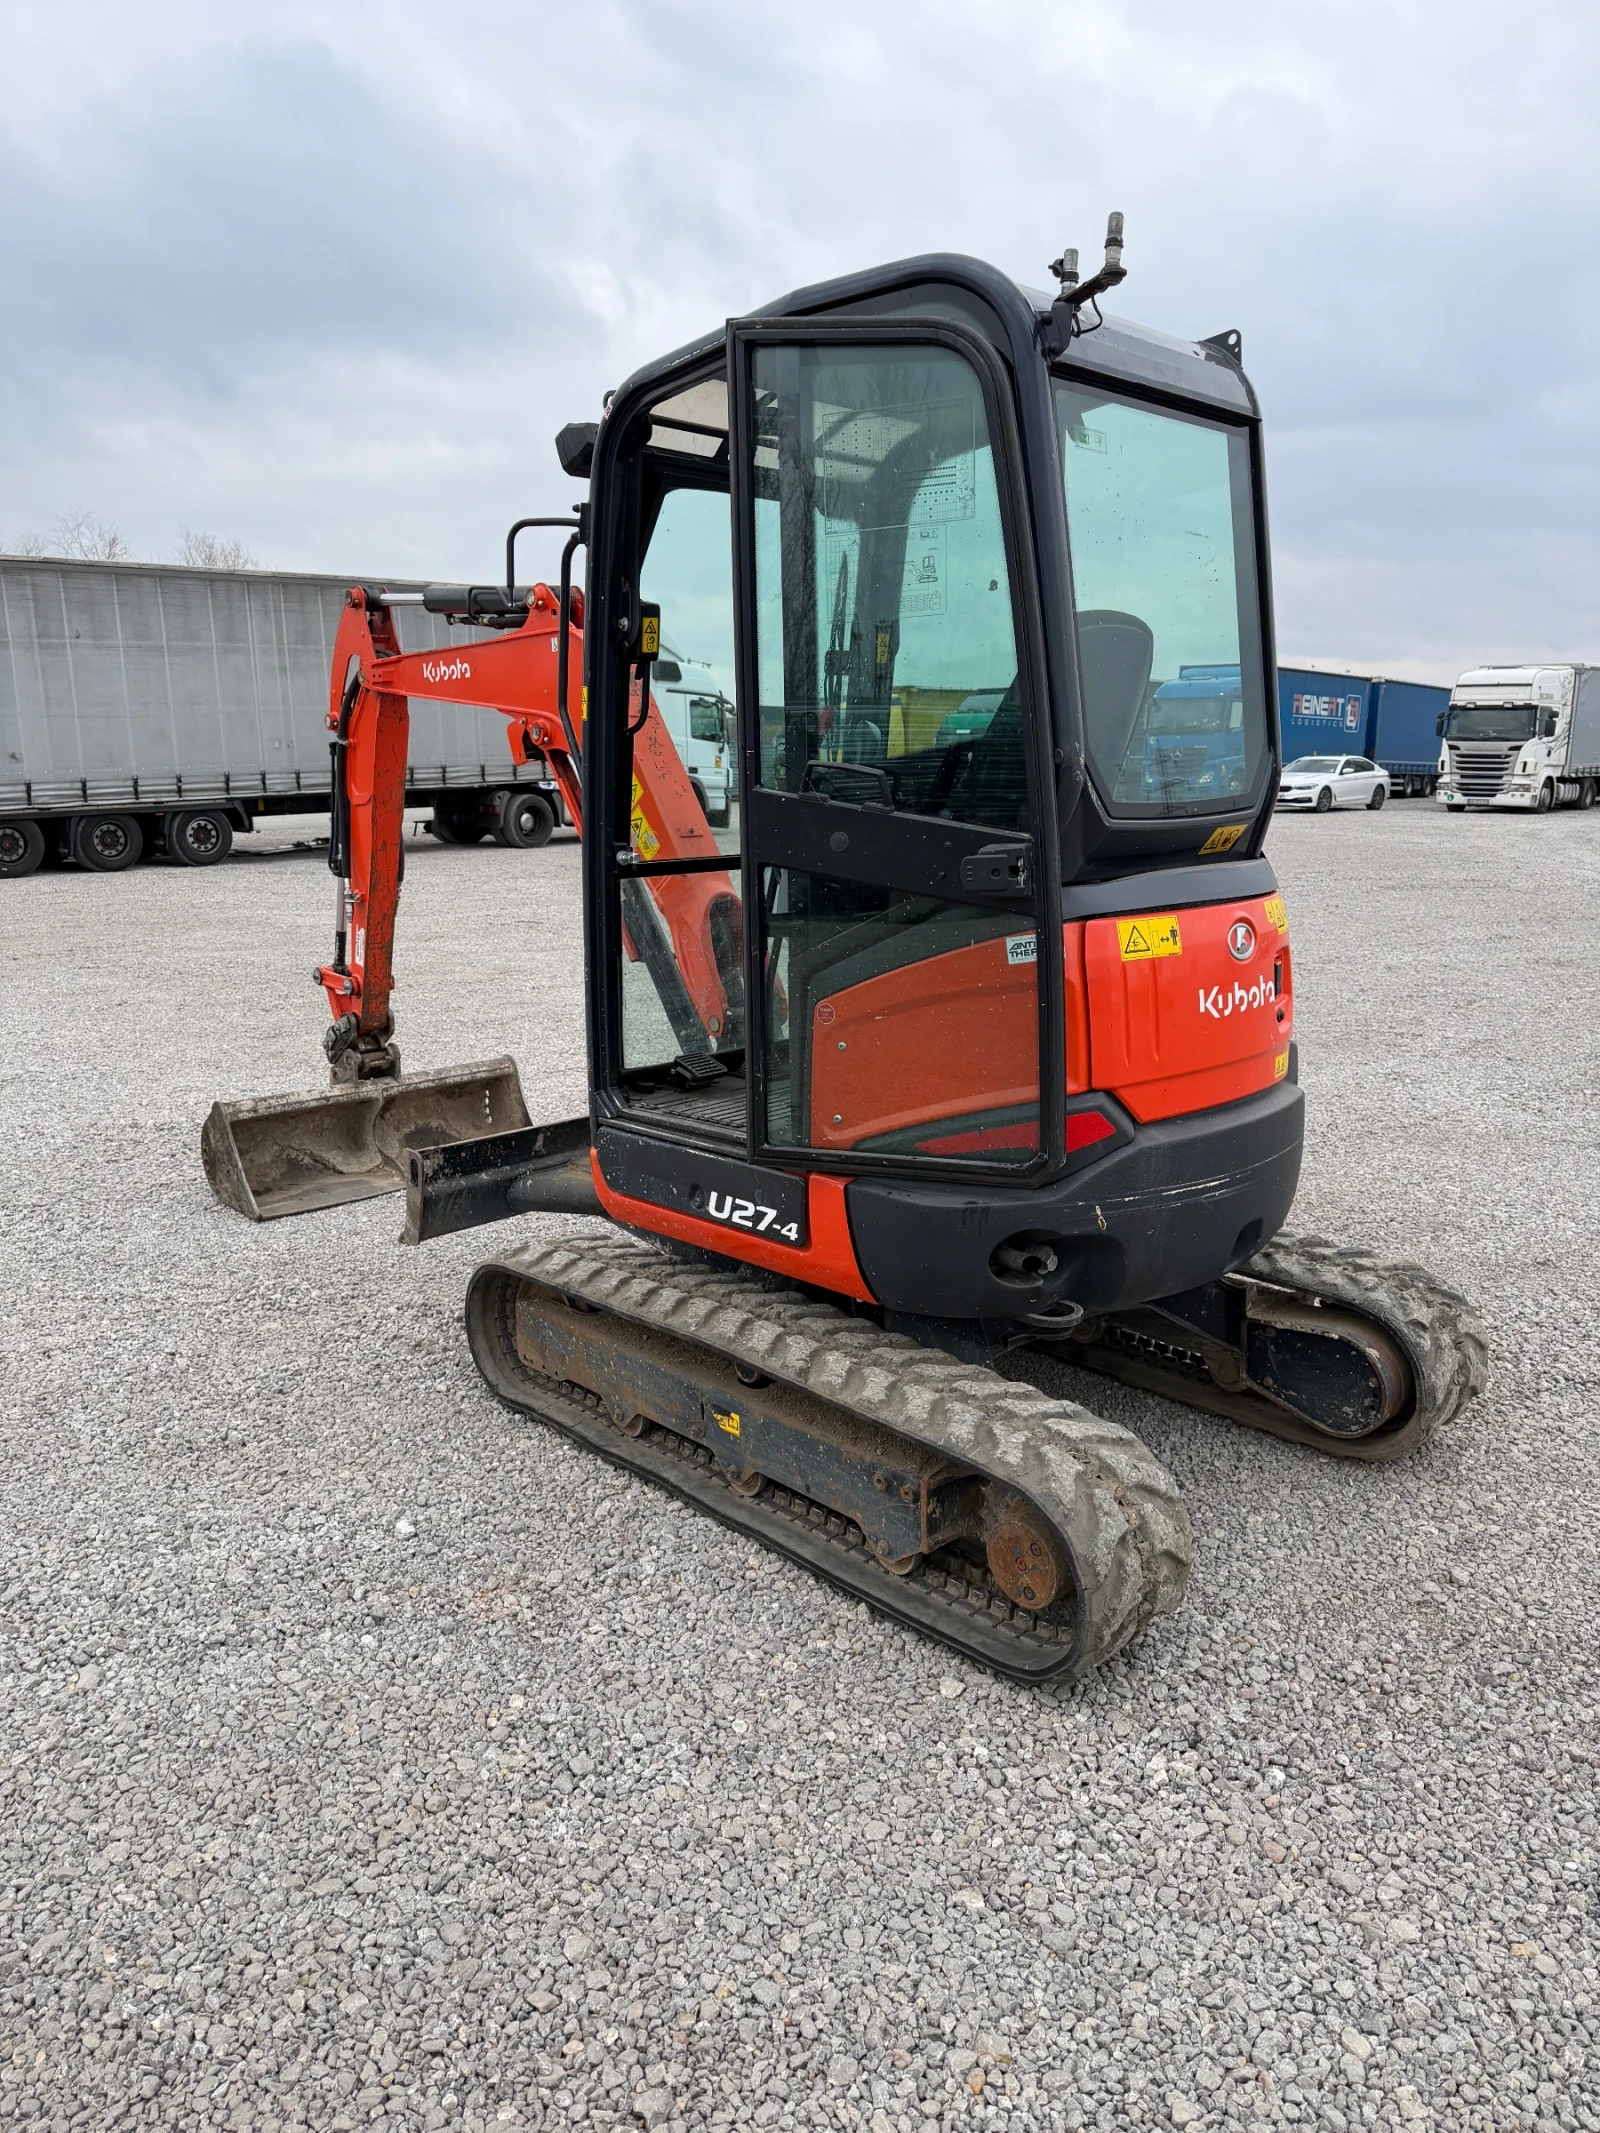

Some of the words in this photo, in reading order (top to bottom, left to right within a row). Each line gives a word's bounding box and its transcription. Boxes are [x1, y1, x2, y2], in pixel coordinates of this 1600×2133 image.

[422, 657, 471, 683] Kubota
[1292, 693, 1345, 717] REINERT
[1291, 718, 1344, 728] LOGISTICS
[1009, 941, 1036, 951] ANTI
[1199, 974, 1276, 1019] Kubota
[708, 1190, 799, 1241] U27-4
